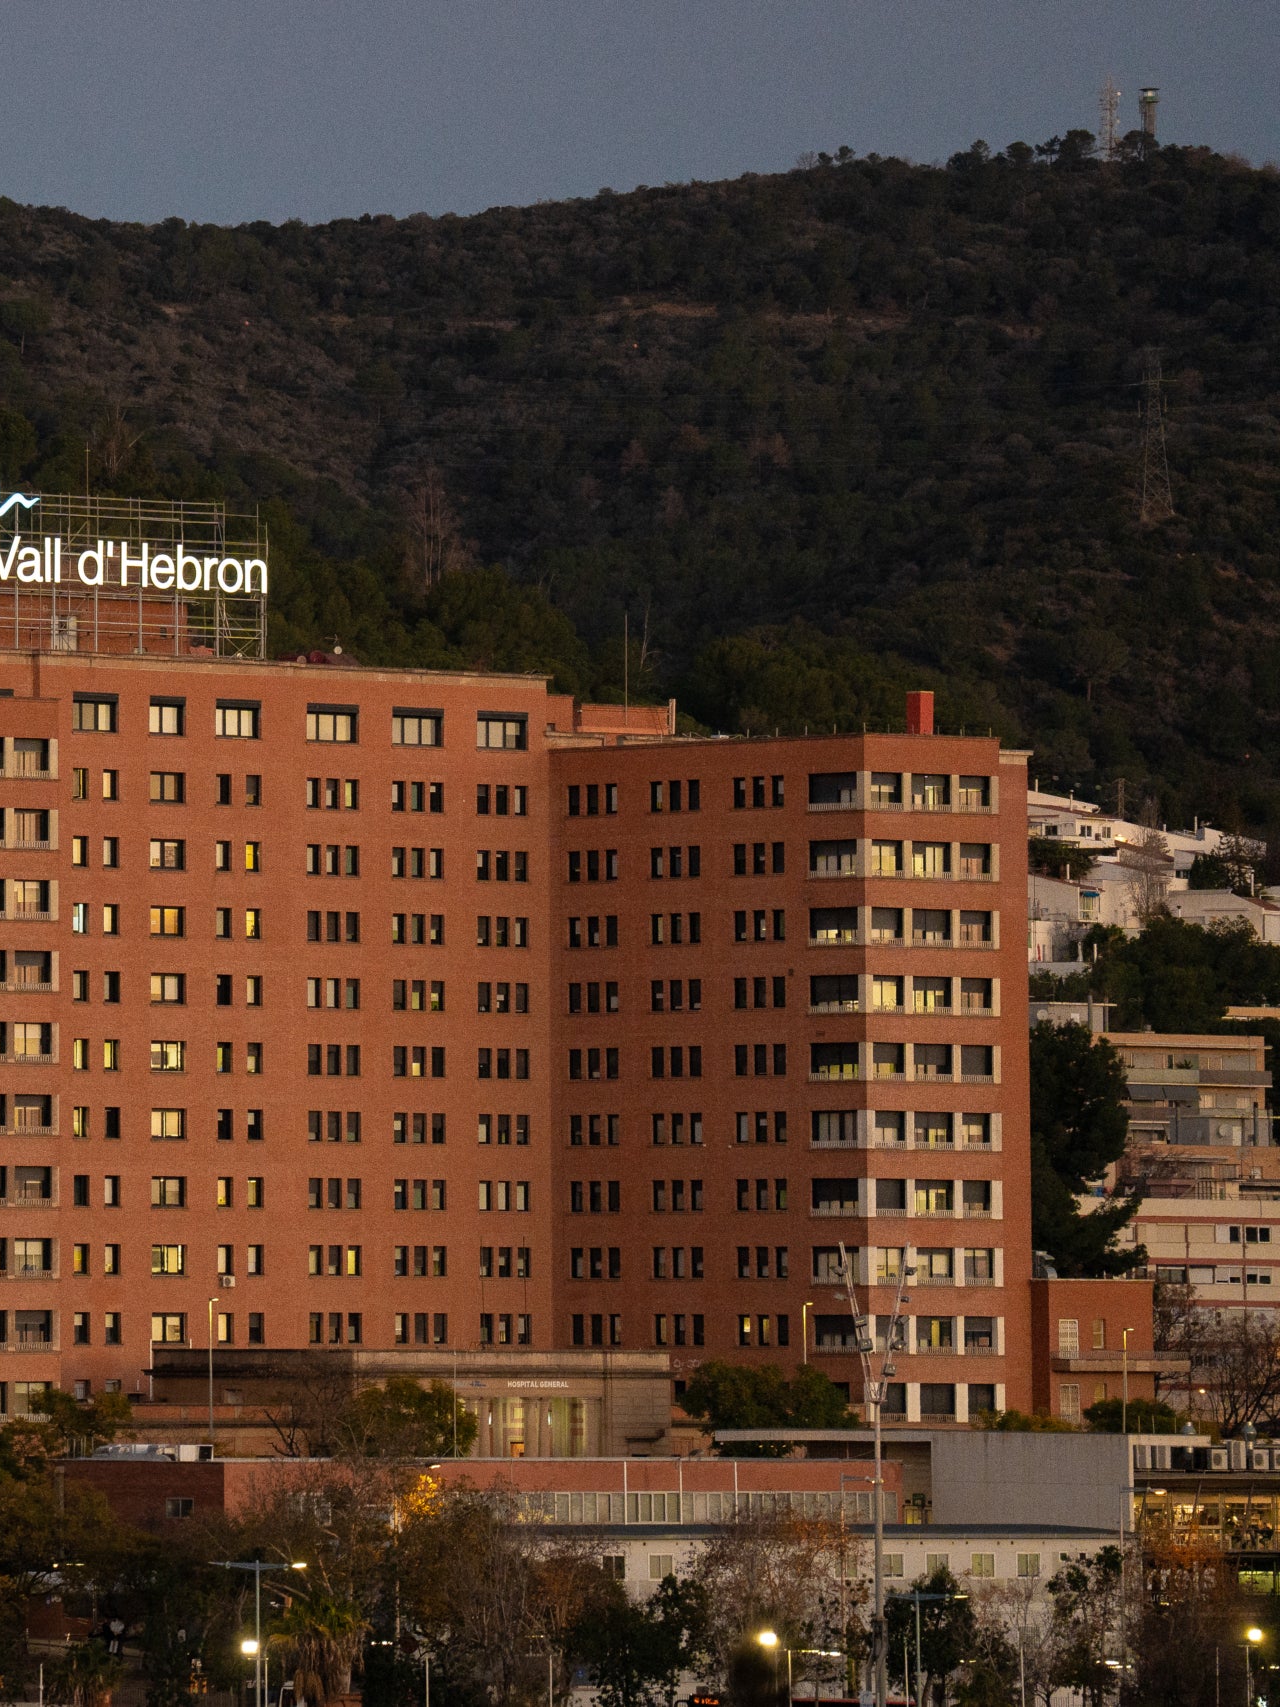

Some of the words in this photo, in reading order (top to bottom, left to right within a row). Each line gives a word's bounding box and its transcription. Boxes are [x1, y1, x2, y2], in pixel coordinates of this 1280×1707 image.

[77, 540, 268, 595] d'Hebron
[507, 1380, 539, 1388] HOSPITAL
[539, 1380, 569, 1388] GENERAL
